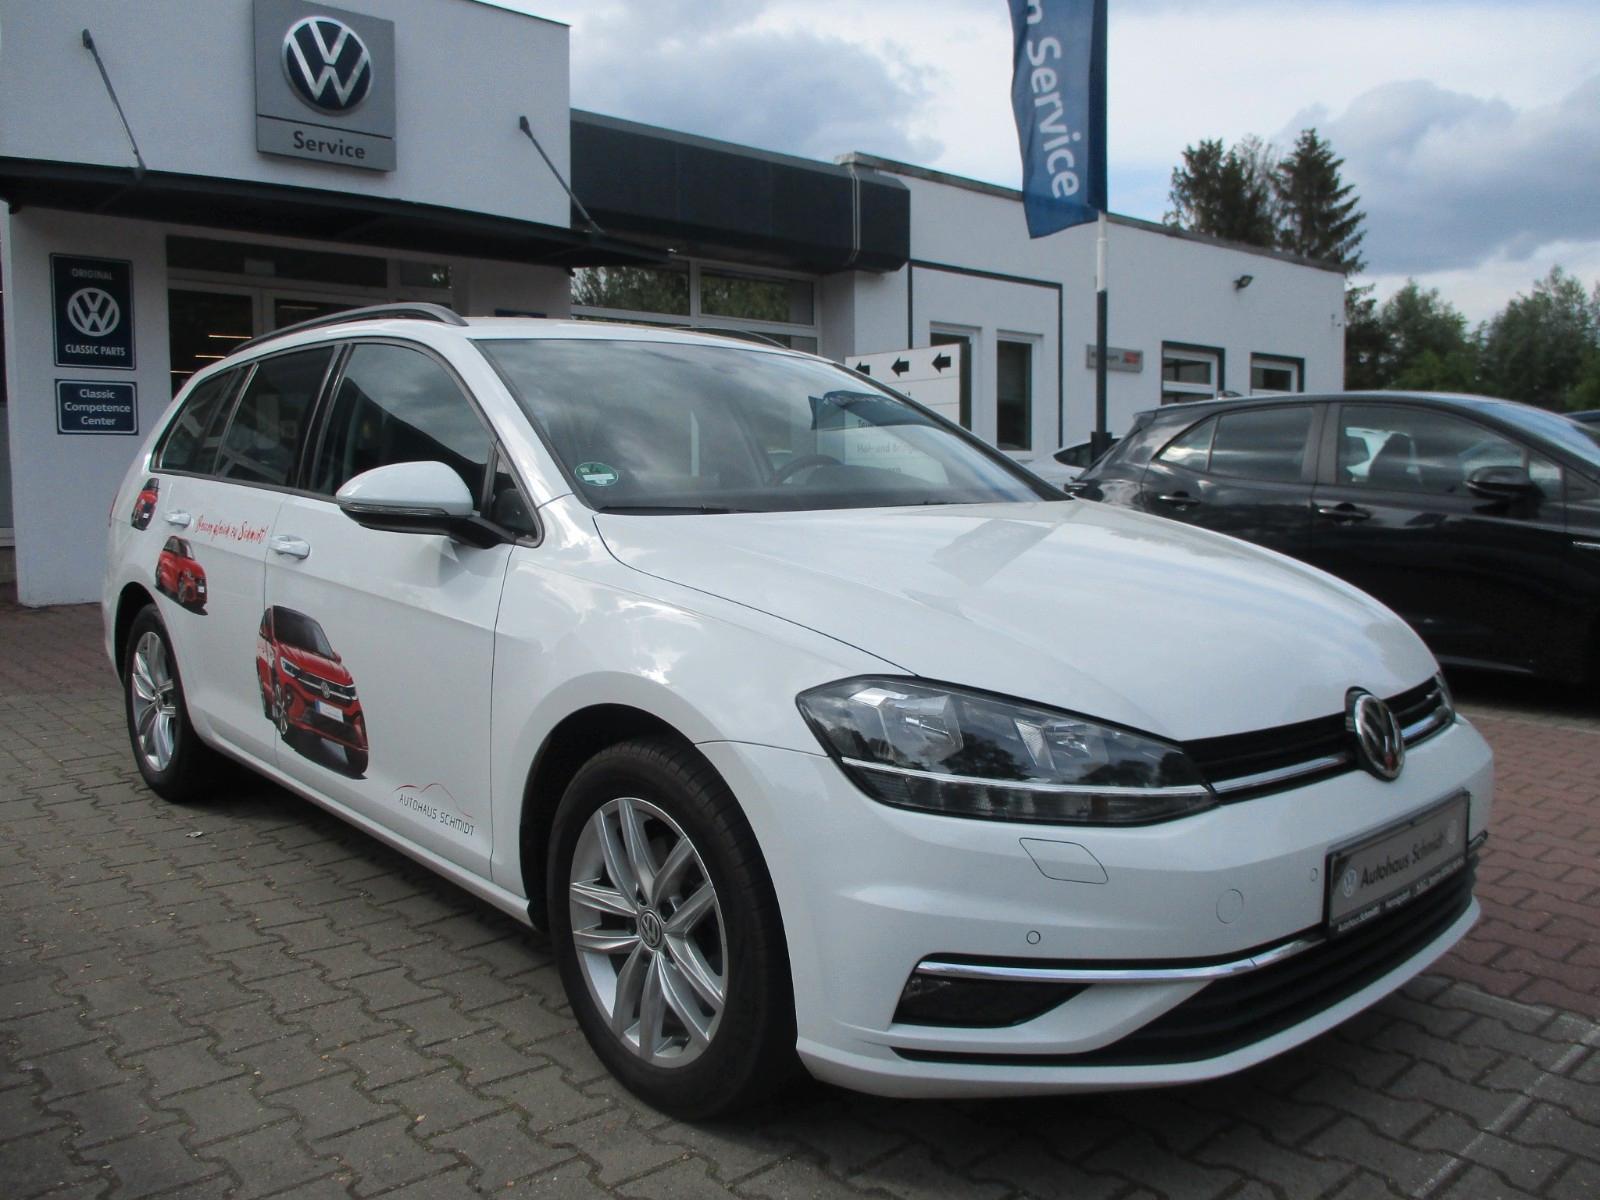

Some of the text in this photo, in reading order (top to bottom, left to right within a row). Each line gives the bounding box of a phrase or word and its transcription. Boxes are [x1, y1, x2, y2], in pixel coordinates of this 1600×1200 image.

[1026, 36, 1081, 199] Service
[293, 130, 366, 161] Service
[71, 268, 113, 280] ORIGINAL
[65, 344, 126, 357] CLASSIC PARTS
[79, 388, 116, 399] Classic
[64, 401, 131, 414] Competence
[81, 415, 117, 426] Center
[399, 793, 475, 836] AUTOHAUS SCHMIDT
[1360, 853, 1409, 888] Autohaus
